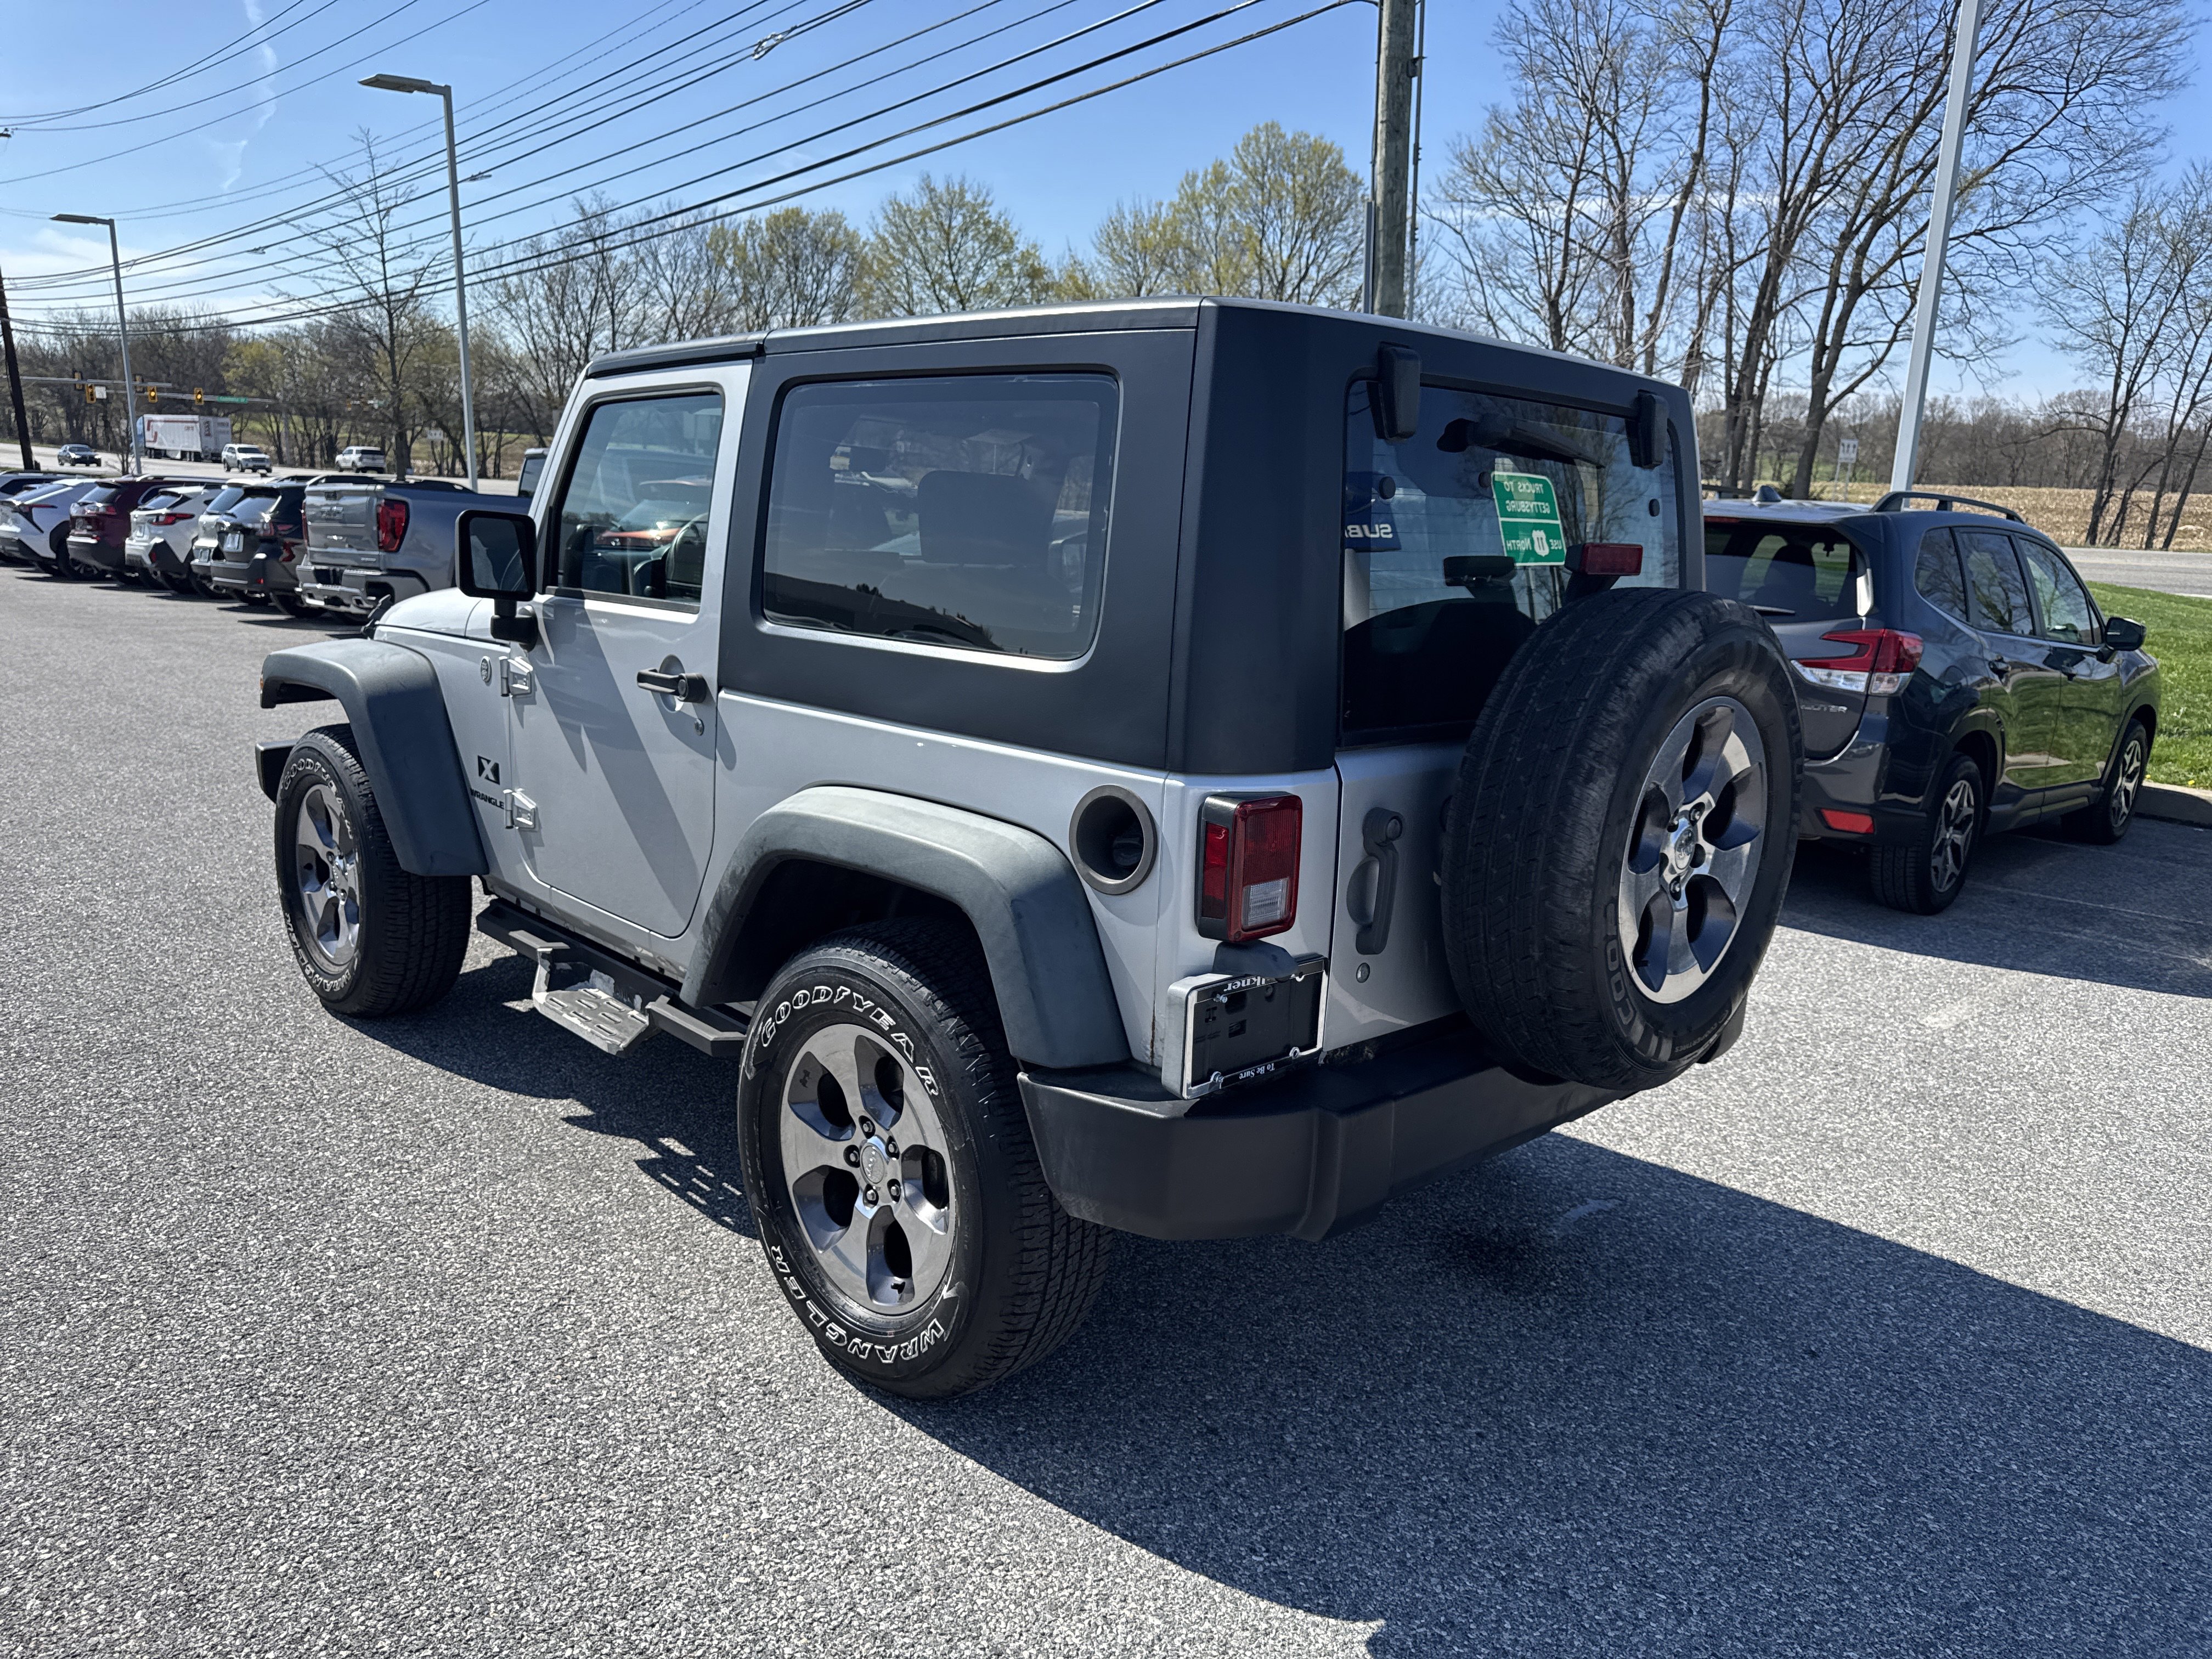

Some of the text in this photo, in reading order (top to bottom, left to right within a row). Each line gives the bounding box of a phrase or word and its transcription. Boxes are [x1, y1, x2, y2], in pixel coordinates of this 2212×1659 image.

[470, 786, 504, 810] WRANGLE
[1223, 976, 1266, 992] lkner
[761, 985, 939, 1096] GOODYEAR
[1239, 1063, 1276, 1080] To Be Sure
[771, 1245, 945, 1363] WRANGLER
